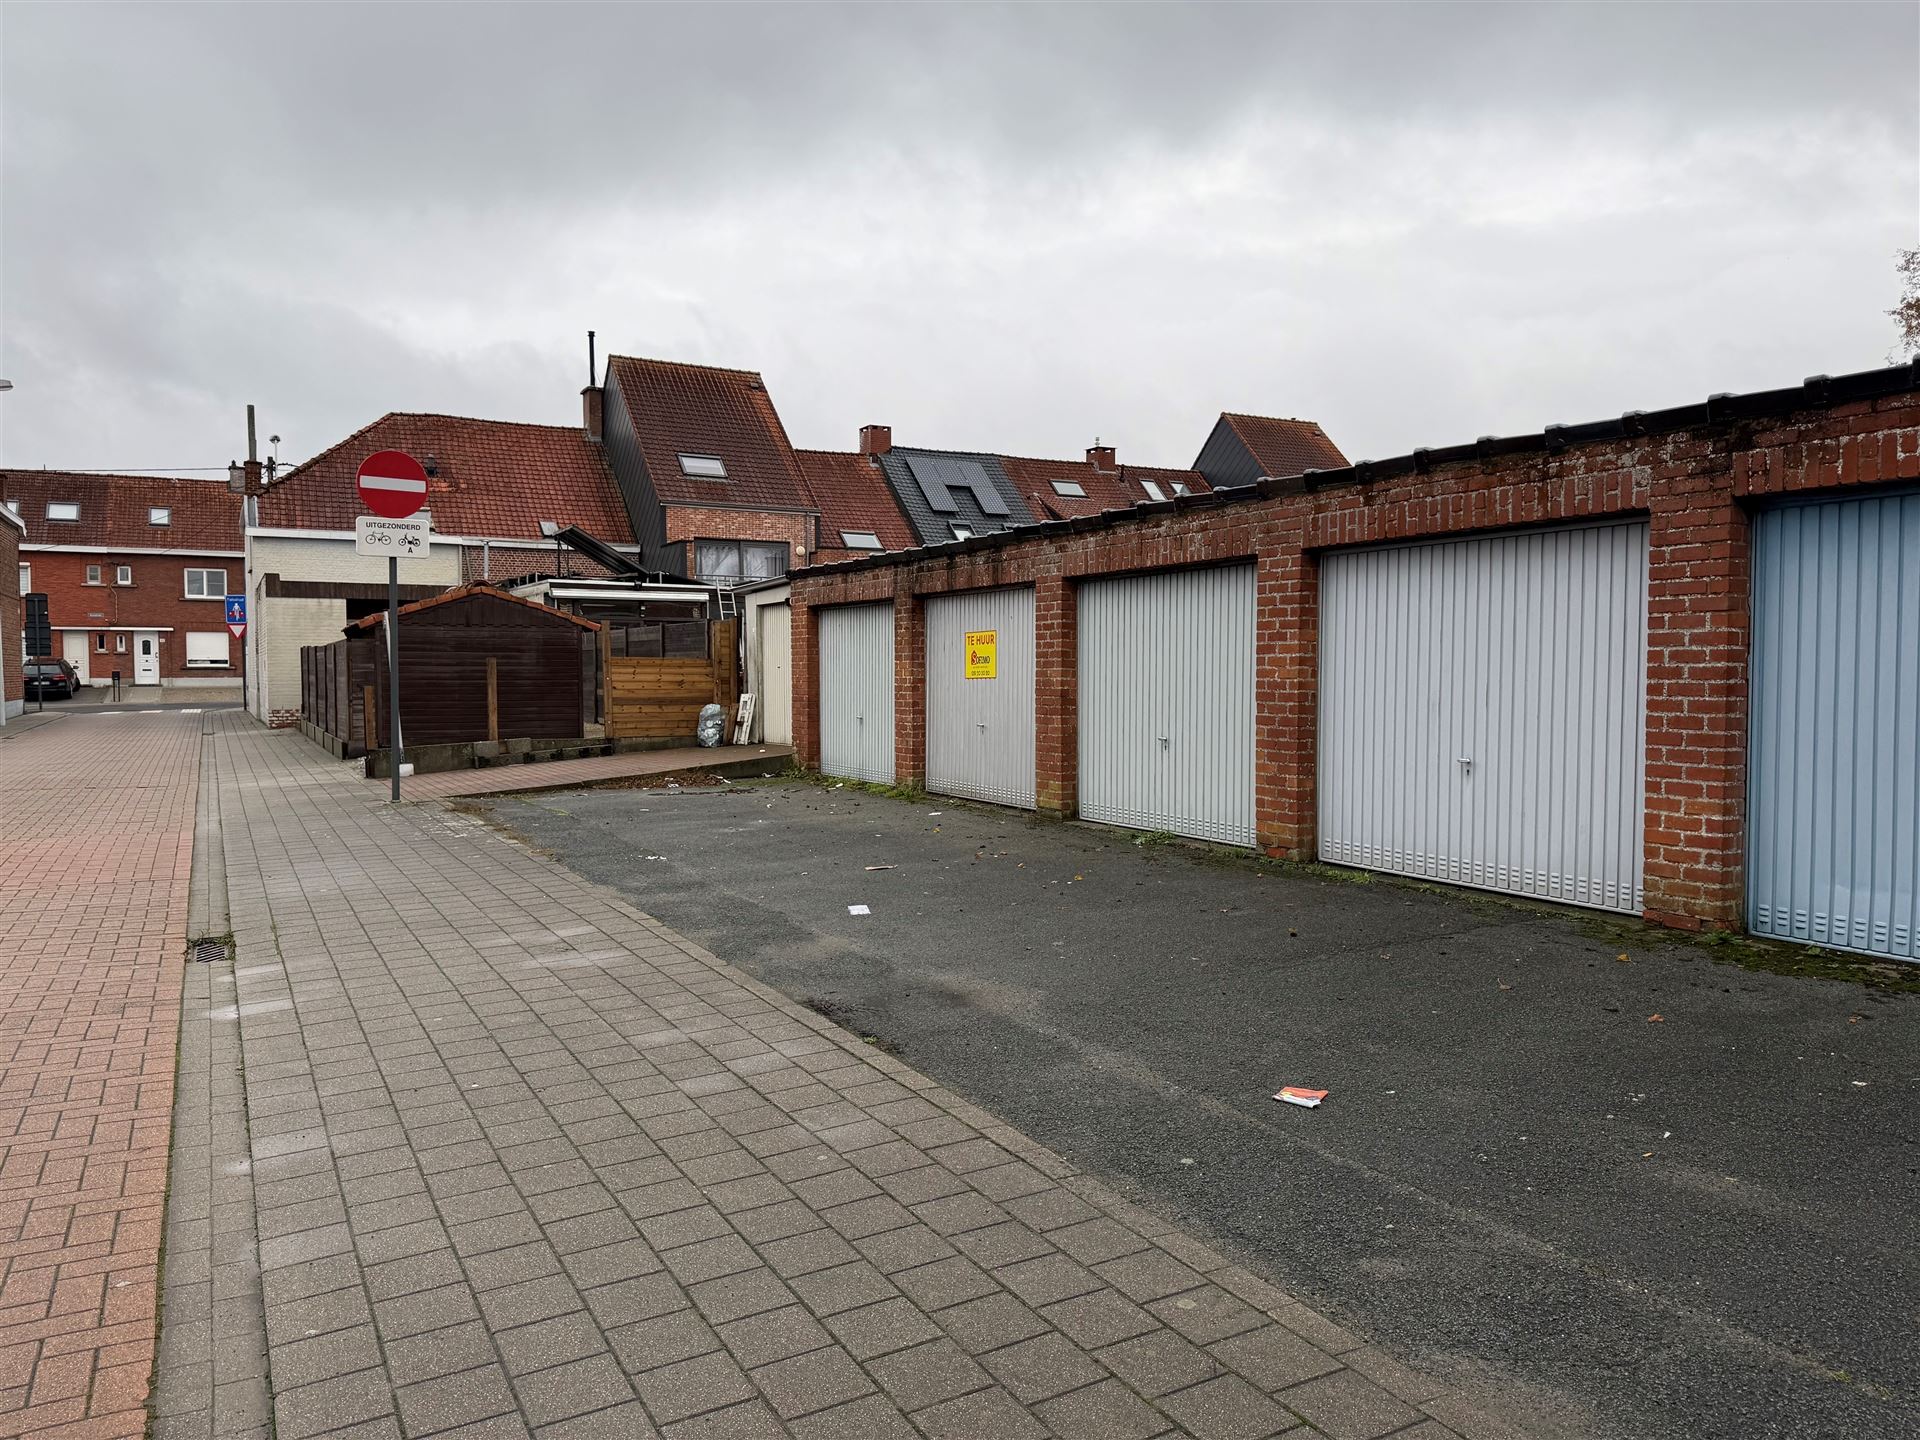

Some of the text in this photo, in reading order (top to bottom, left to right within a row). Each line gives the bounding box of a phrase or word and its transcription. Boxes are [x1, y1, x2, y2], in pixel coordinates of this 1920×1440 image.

[366, 522, 420, 530] UITGEZONDERD
[967, 634, 994, 645] TE HUUR
